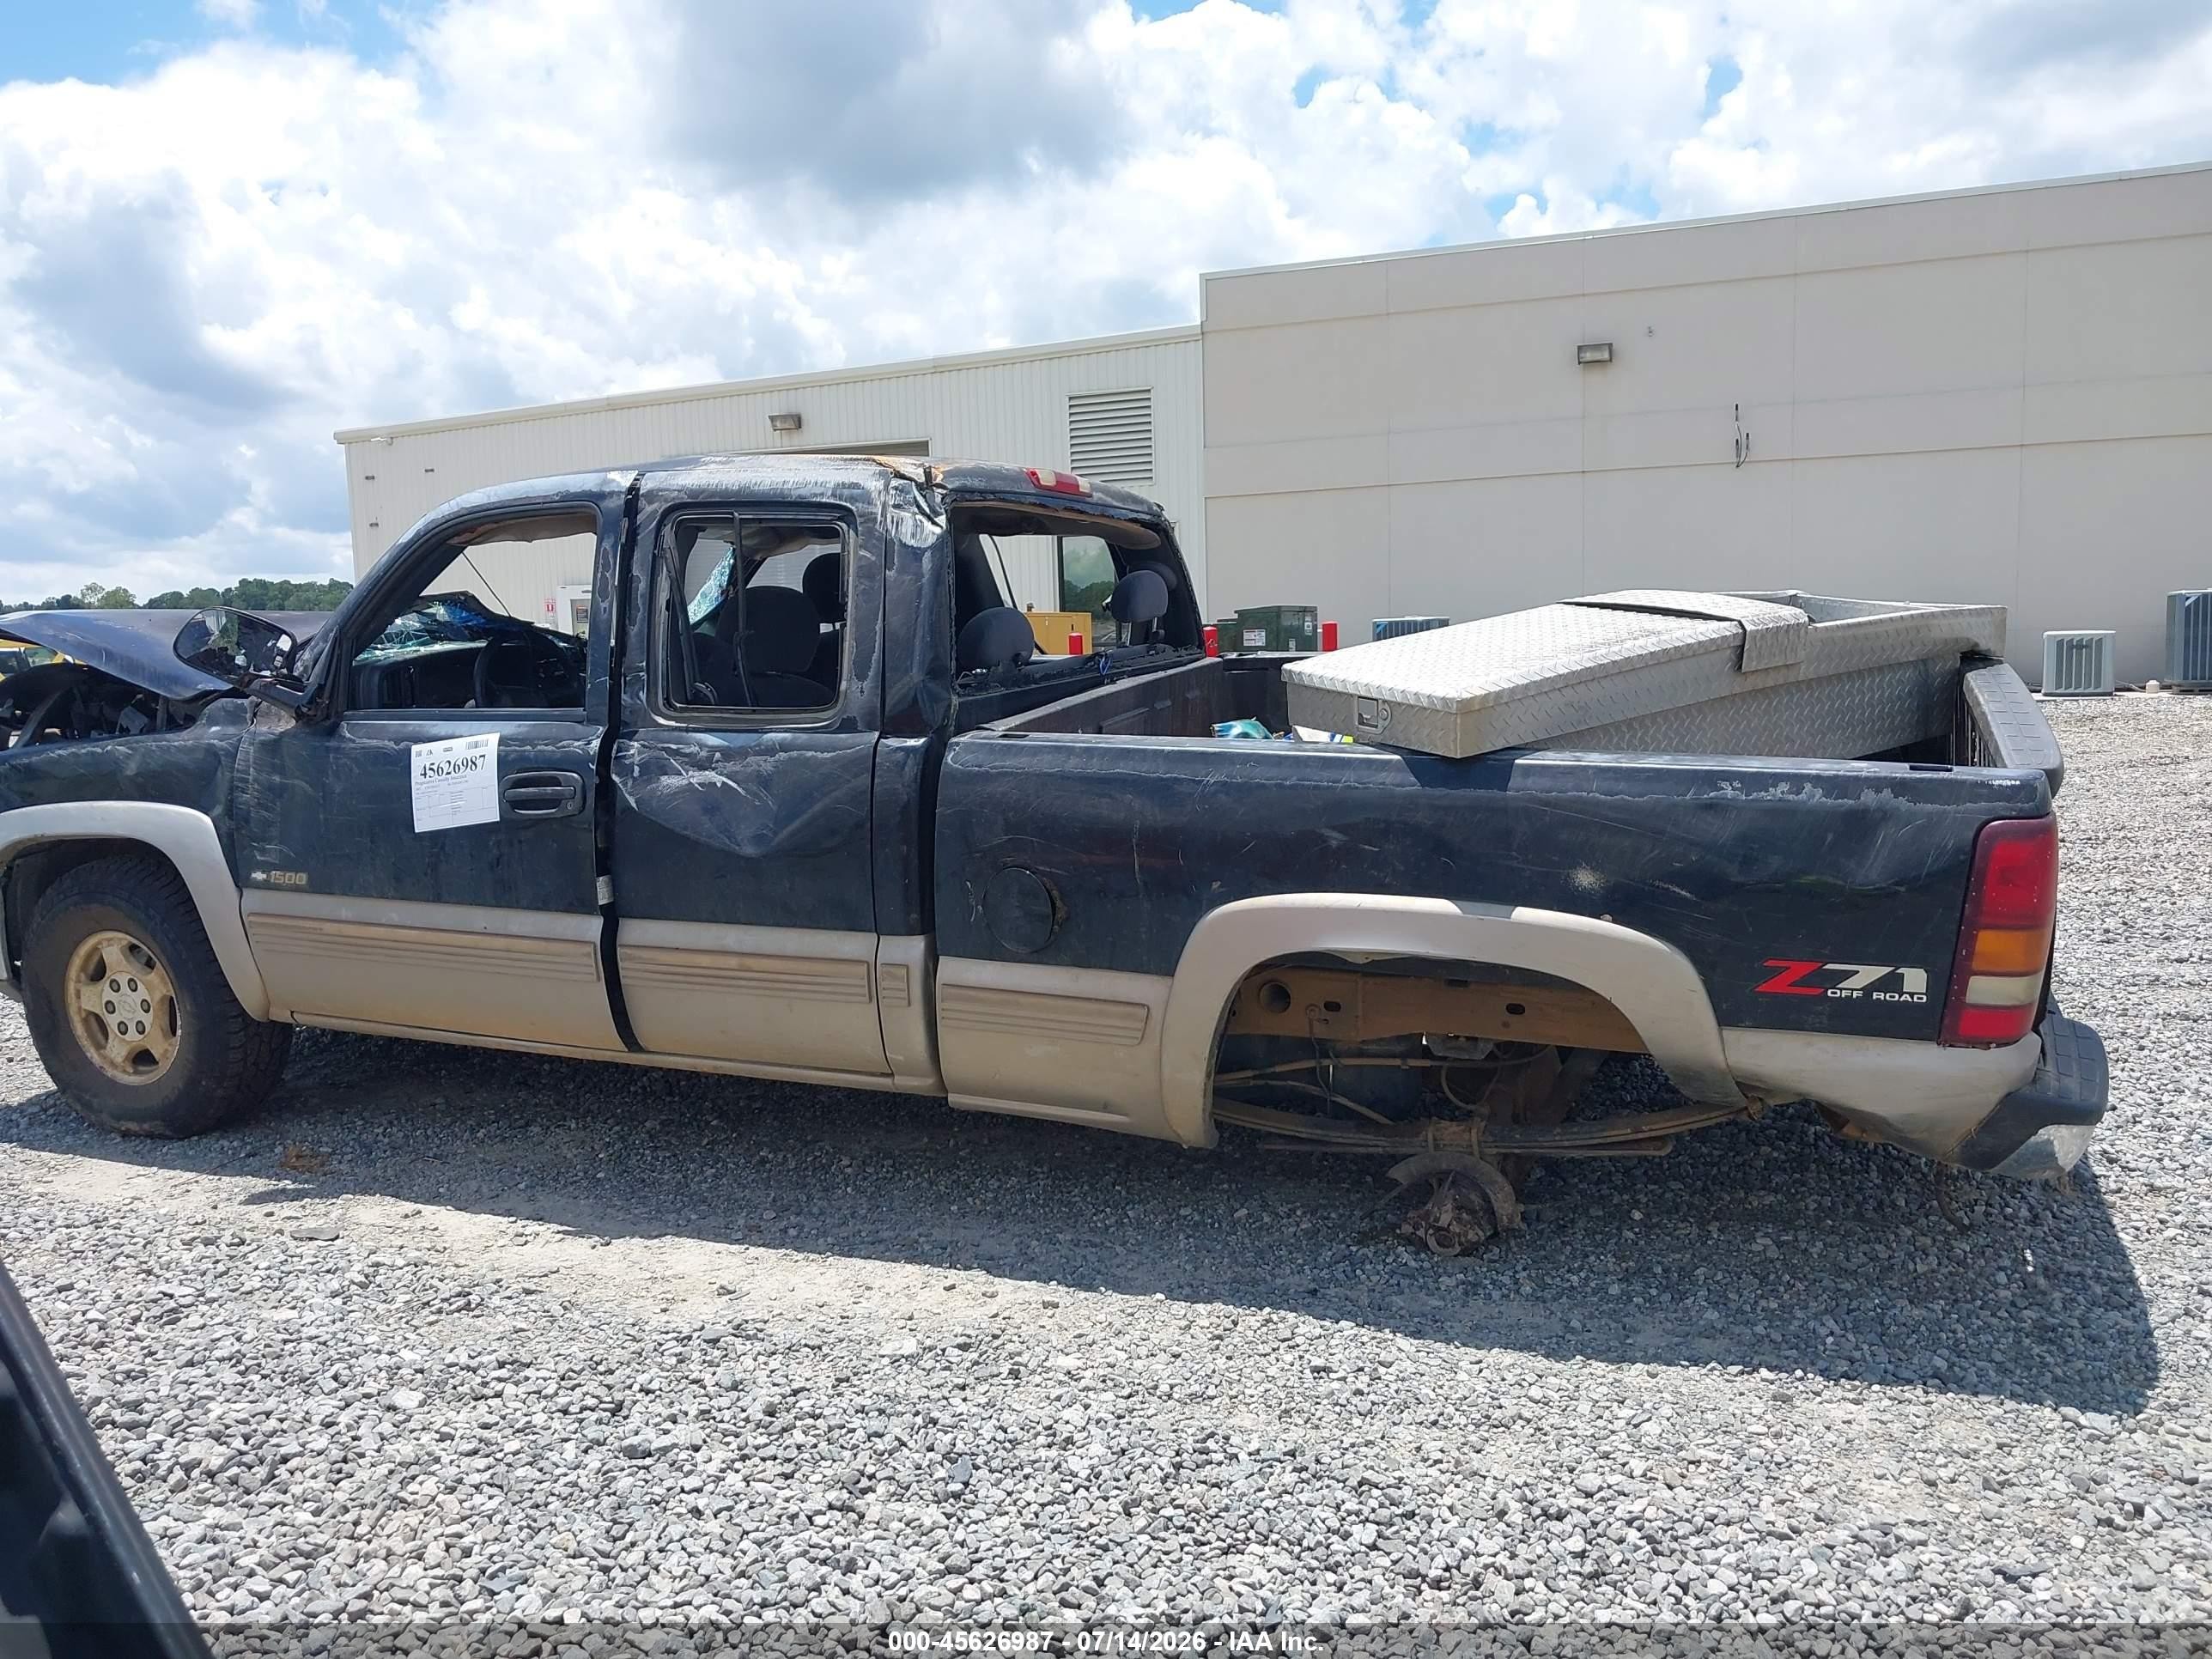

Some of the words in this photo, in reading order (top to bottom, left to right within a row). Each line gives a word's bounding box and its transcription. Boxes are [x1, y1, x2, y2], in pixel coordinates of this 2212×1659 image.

[420, 754, 486, 779] 45626987
[270, 871, 307, 884] 1500
[1754, 958, 1928, 995] Z71
[1827, 988, 1863, 999] OFF
[1872, 991, 1927, 1003] ROAD
